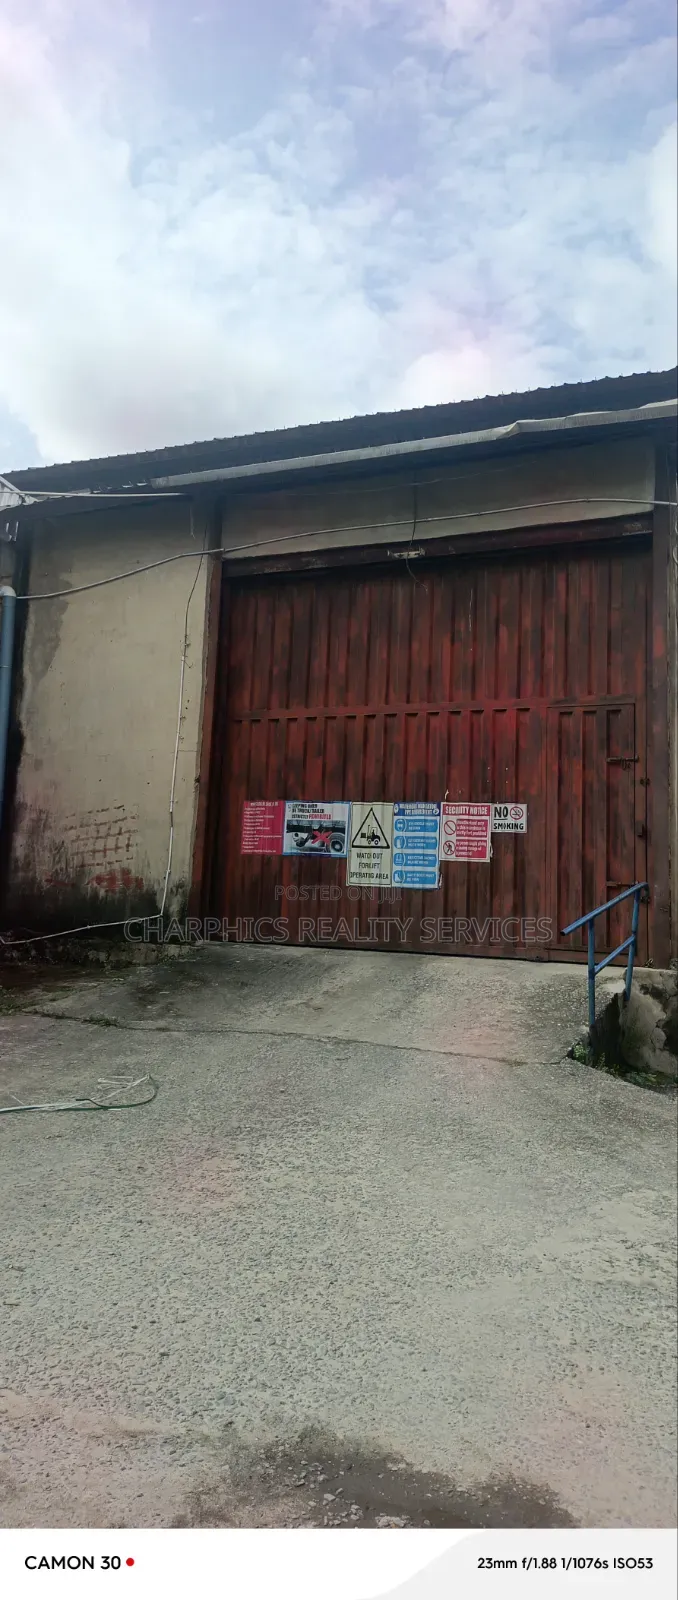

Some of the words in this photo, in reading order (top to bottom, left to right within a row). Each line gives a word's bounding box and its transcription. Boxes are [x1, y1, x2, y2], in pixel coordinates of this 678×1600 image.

[445, 805, 470, 815] SECURITY
[470, 806, 488, 815] NOTICE
[493, 805, 509, 818] NO
[493, 822, 524, 830] SMOKING
[375, 872, 389, 880] AREA
